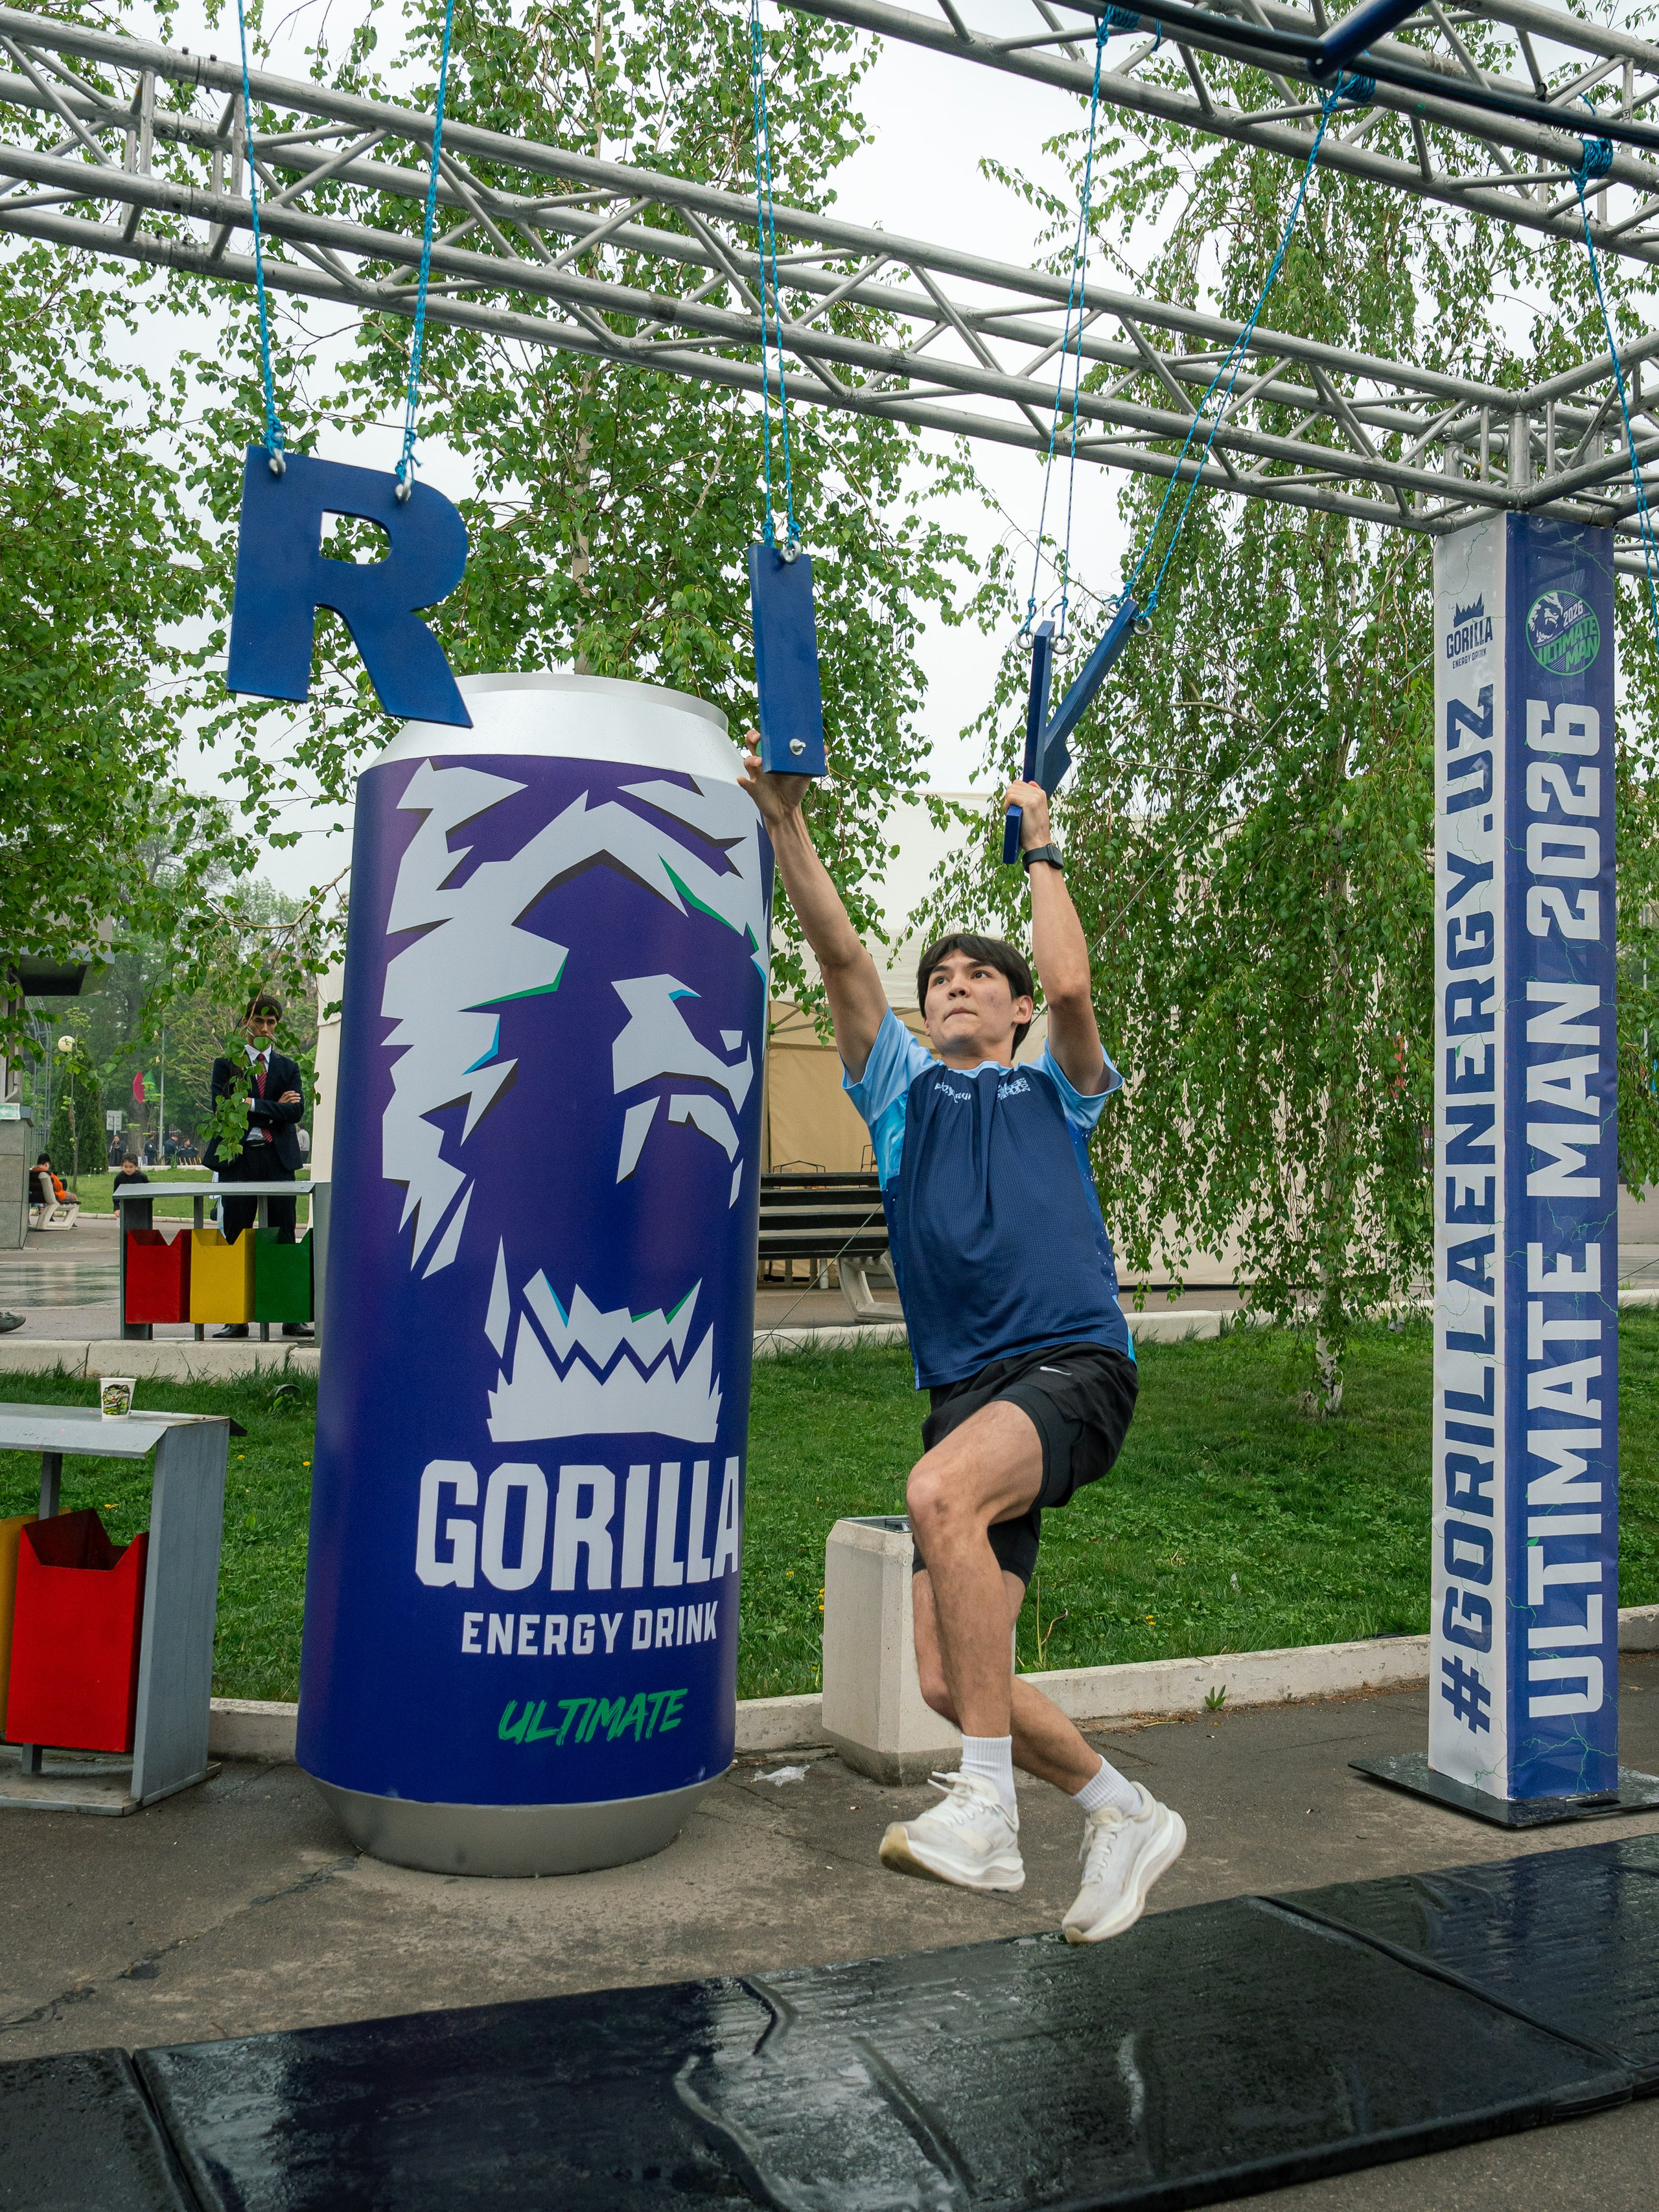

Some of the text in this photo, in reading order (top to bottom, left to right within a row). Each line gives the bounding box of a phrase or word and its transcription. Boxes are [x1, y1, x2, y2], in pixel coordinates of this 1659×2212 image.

[1446, 616, 1493, 659] GORILLA
[1538, 616, 1597, 666] ULTIMATE
[1563, 600, 1583, 627] 2026
[1452, 654, 1471, 669] ENERGY
[1565, 636, 1598, 672] MAN
[1526, 699, 1600, 940] 2026
[1526, 981, 1601, 1197] MAN
[1441, 684, 1495, 1734] #GORILLAENERGY.UZ
[1527, 1242, 1603, 1718] ULTIMATE
[415, 1456, 739, 1590] GORILLA
[461, 1600, 718, 1655] ENERGY DRINK
[497, 1688, 688, 1746] ULTIMATE
